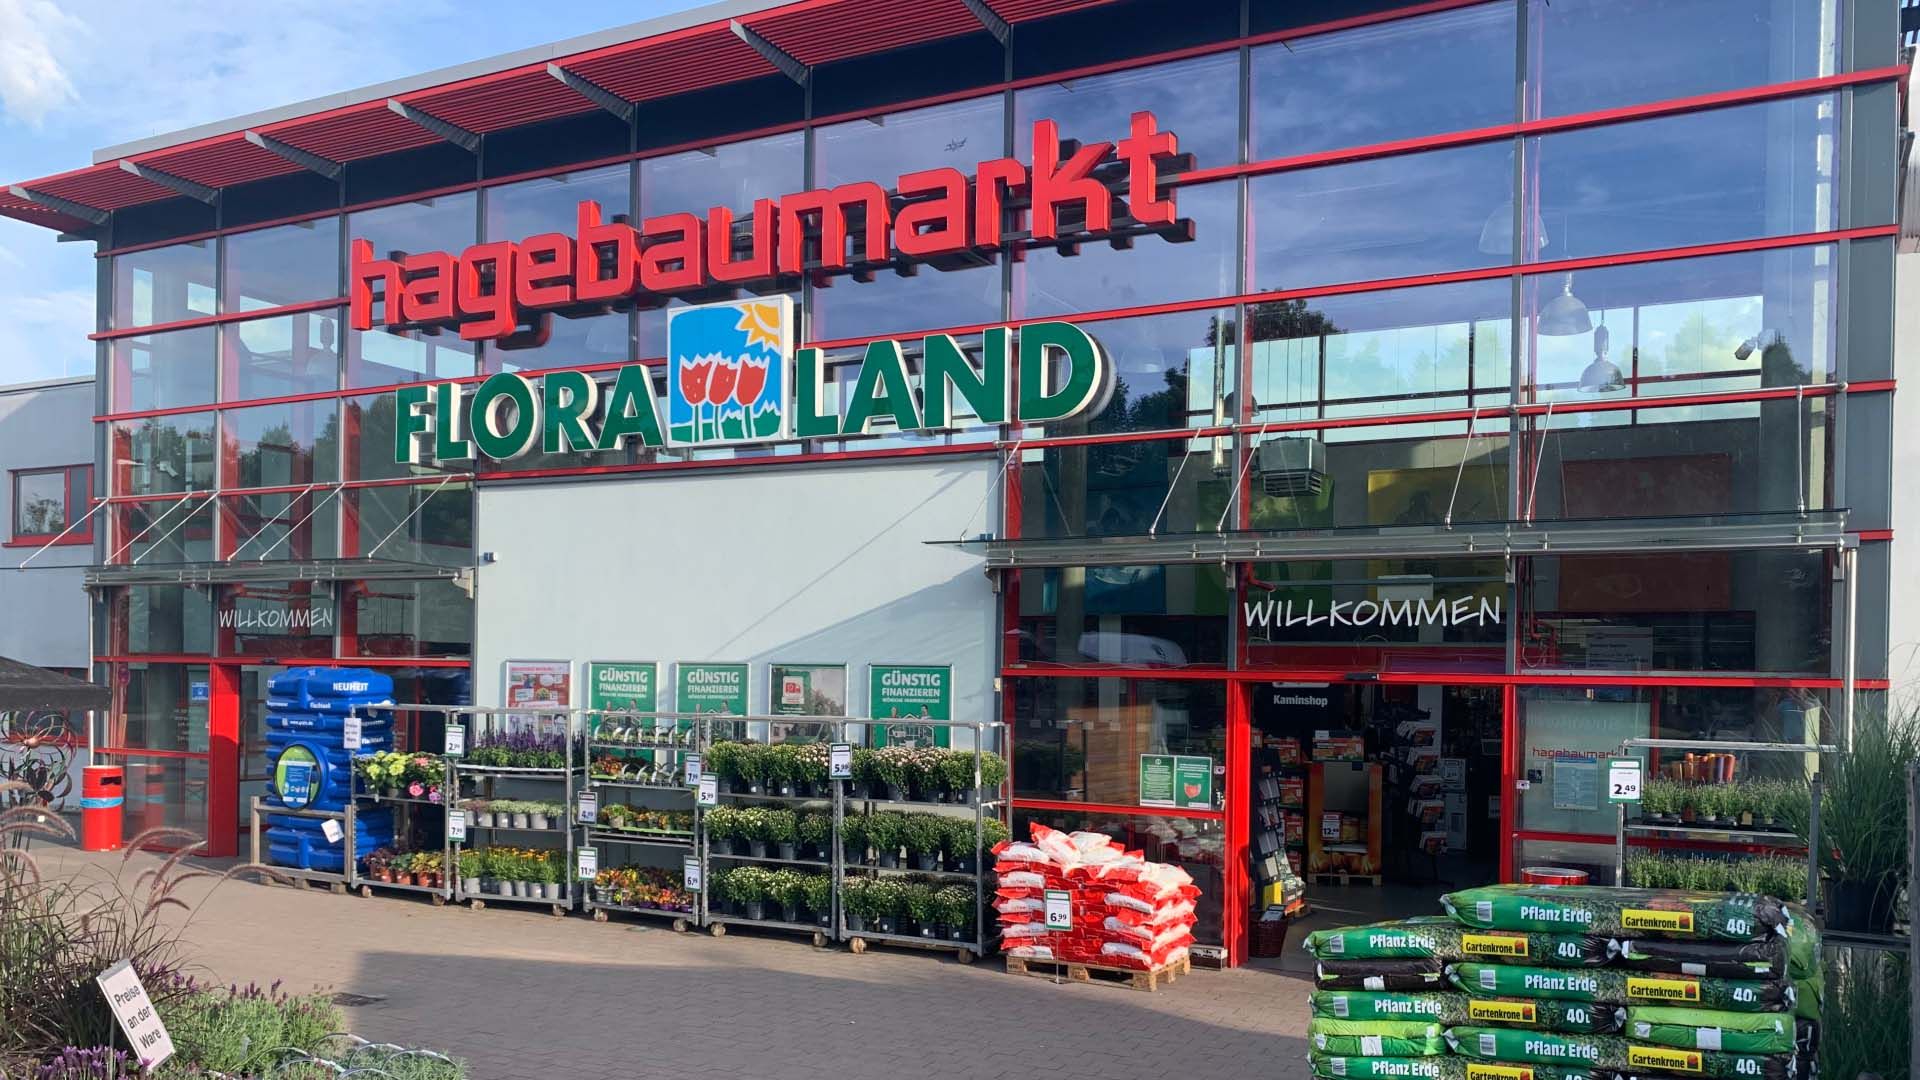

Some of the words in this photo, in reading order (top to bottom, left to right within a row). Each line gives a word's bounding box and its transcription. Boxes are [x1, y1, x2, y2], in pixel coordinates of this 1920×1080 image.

[351, 111, 1177, 341] hagebaumarkt
[394, 362, 667, 464] FLORA
[796, 320, 1112, 438] LAND
[219, 607, 333, 628] WILLKOMMEN
[1245, 596, 1501, 628] WILLKOMMEN
[599, 667, 648, 683] GÜNSTIG
[688, 668, 739, 683] GÜNSTIG
[881, 670, 941, 686] GÜNSTIG
[333, 682, 368, 692] NEUHEIT
[599, 683, 648, 693] FINANZIEREN
[688, 685, 739, 693] FINANZIEREN
[881, 687, 941, 697] FINANZIEREN
[1273, 694, 1328, 708] Kaminshop
[1613, 783, 1636, 795] 2.49
[1050, 912, 1067, 923] 6.99
[1520, 906, 1560, 921] Pflanz
[1563, 908, 1592, 924] Erde
[1625, 917, 1677, 930] Gartenkrone
[1369, 934, 1406, 949] Pflanz
[1408, 935, 1435, 949] Erde
[1465, 942, 1513, 954] Gartenkrone
[1524, 974, 1565, 991] Pflanz
[1567, 976, 1597, 992] Erde
[113, 984, 141, 1007] Preise
[1630, 984, 1683, 999] Gartenkrone
[1375, 999, 1412, 1014] Pflanz
[1414, 1000, 1442, 1014] Erde
[1472, 1008, 1521, 1020] Gartenkrone
[127, 1015, 140, 1029] an
[137, 1006, 152, 1021] der
[139, 1029, 162, 1049] Ware
[1525, 1040, 1566, 1057] Pflanz
[1568, 1042, 1598, 1060] Erde
[1372, 1060, 1409, 1076] Pflanz
[1412, 1062, 1439, 1077] Erde
[1632, 1054, 1685, 1068] Gartenkrone
